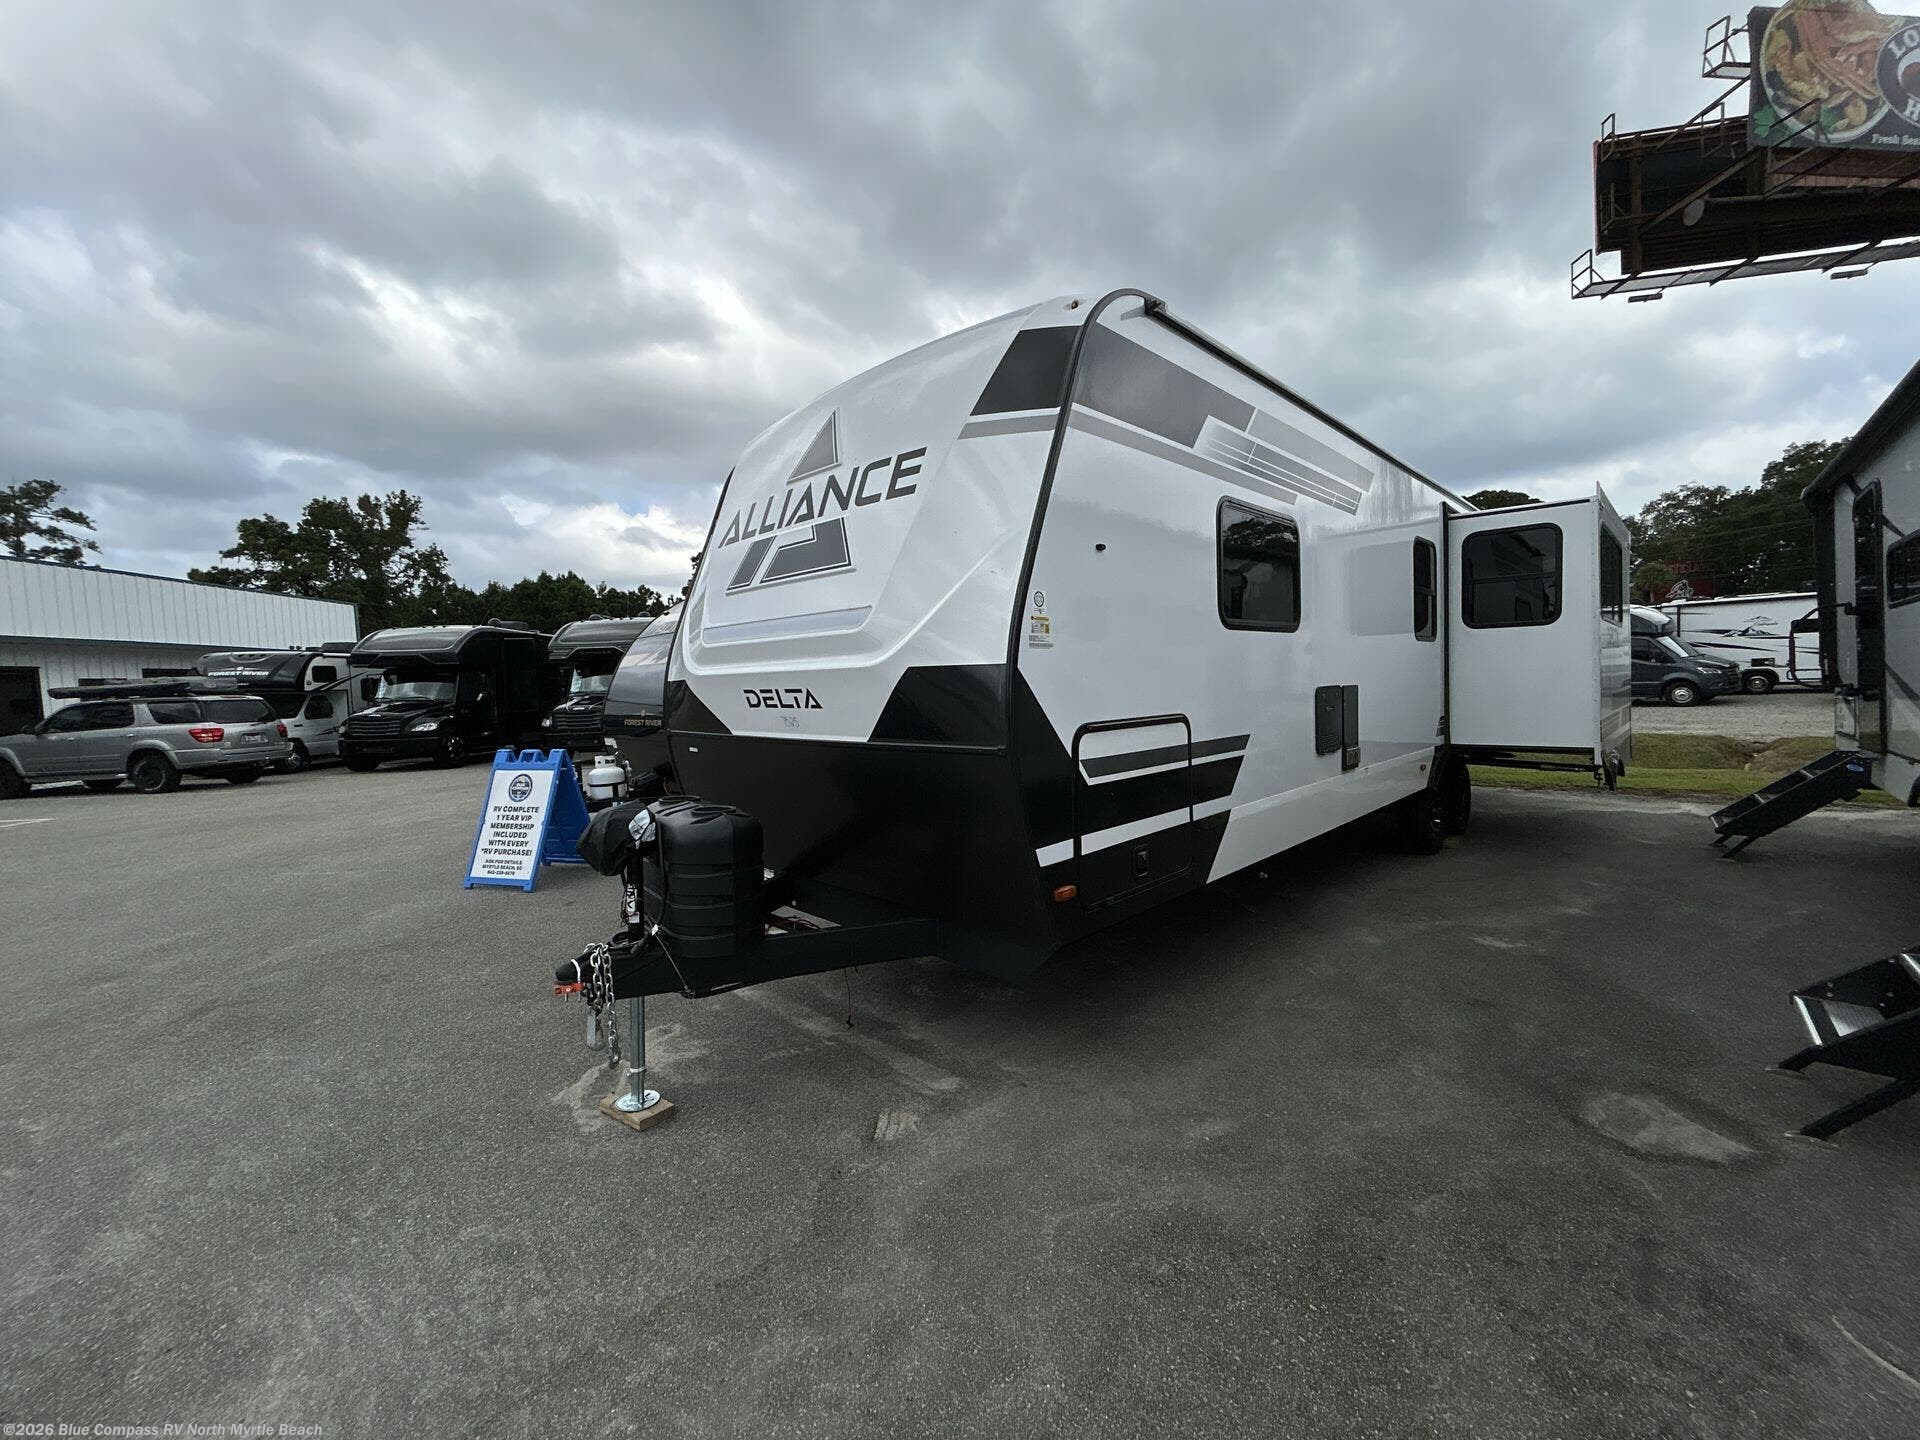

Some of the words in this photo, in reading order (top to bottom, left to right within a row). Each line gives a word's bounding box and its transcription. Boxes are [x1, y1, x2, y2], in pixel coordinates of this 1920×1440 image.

[1872, 133, 1900, 145] Fresh
[718, 446, 927, 549] ALLIANCE
[743, 688, 823, 709] DELTA
[490, 822, 535, 830] MEMBERSHIP
